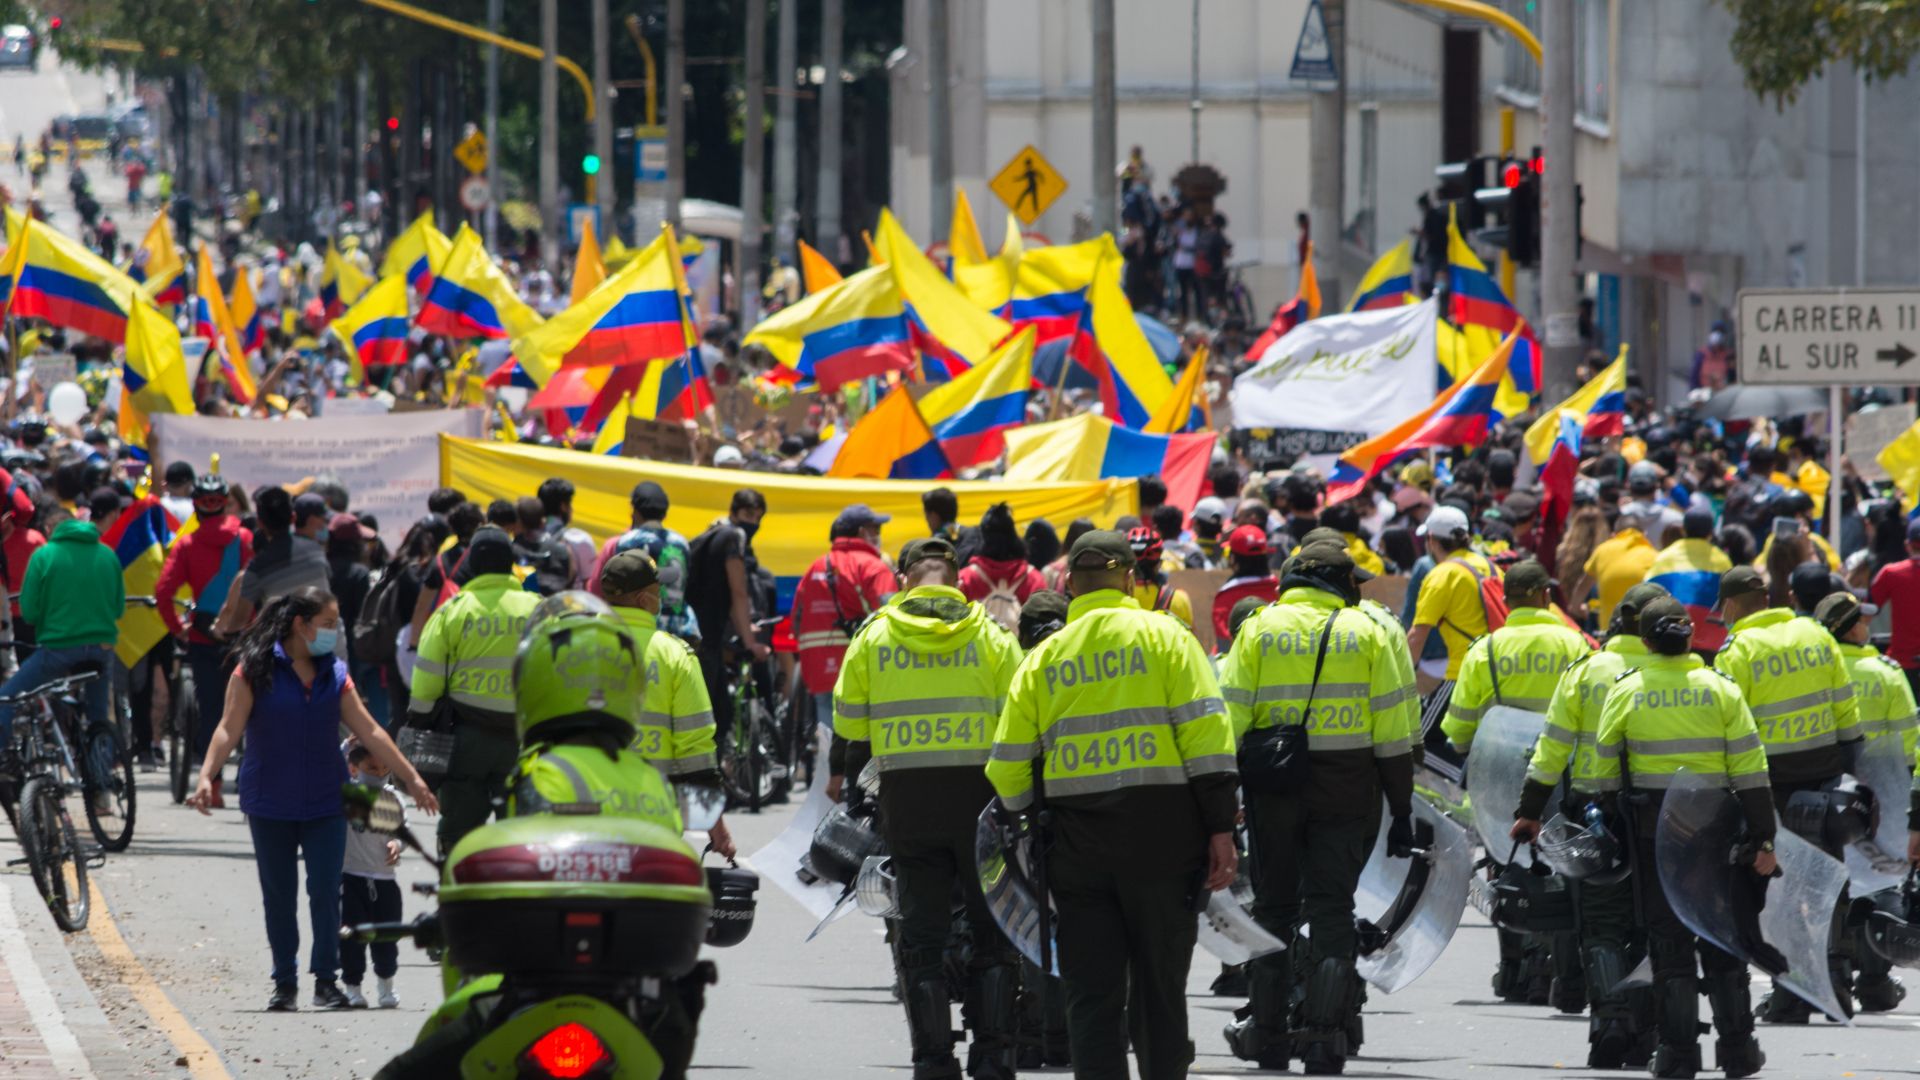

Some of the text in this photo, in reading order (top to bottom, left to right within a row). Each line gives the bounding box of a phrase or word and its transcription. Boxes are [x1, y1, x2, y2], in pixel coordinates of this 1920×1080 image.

[1756, 304, 1917, 332] CARRERA 11
[1757, 342, 1859, 371] AL SUR
[878, 641, 980, 672] POLICIA
[1044, 646, 1149, 696] POLICIA
[1496, 651, 1569, 676] OLICIA
[1752, 645, 1834, 684] POLICIA
[1633, 687, 1714, 711] POLICIA
[881, 716, 986, 749] 709541
[1050, 732, 1157, 774] 704016
